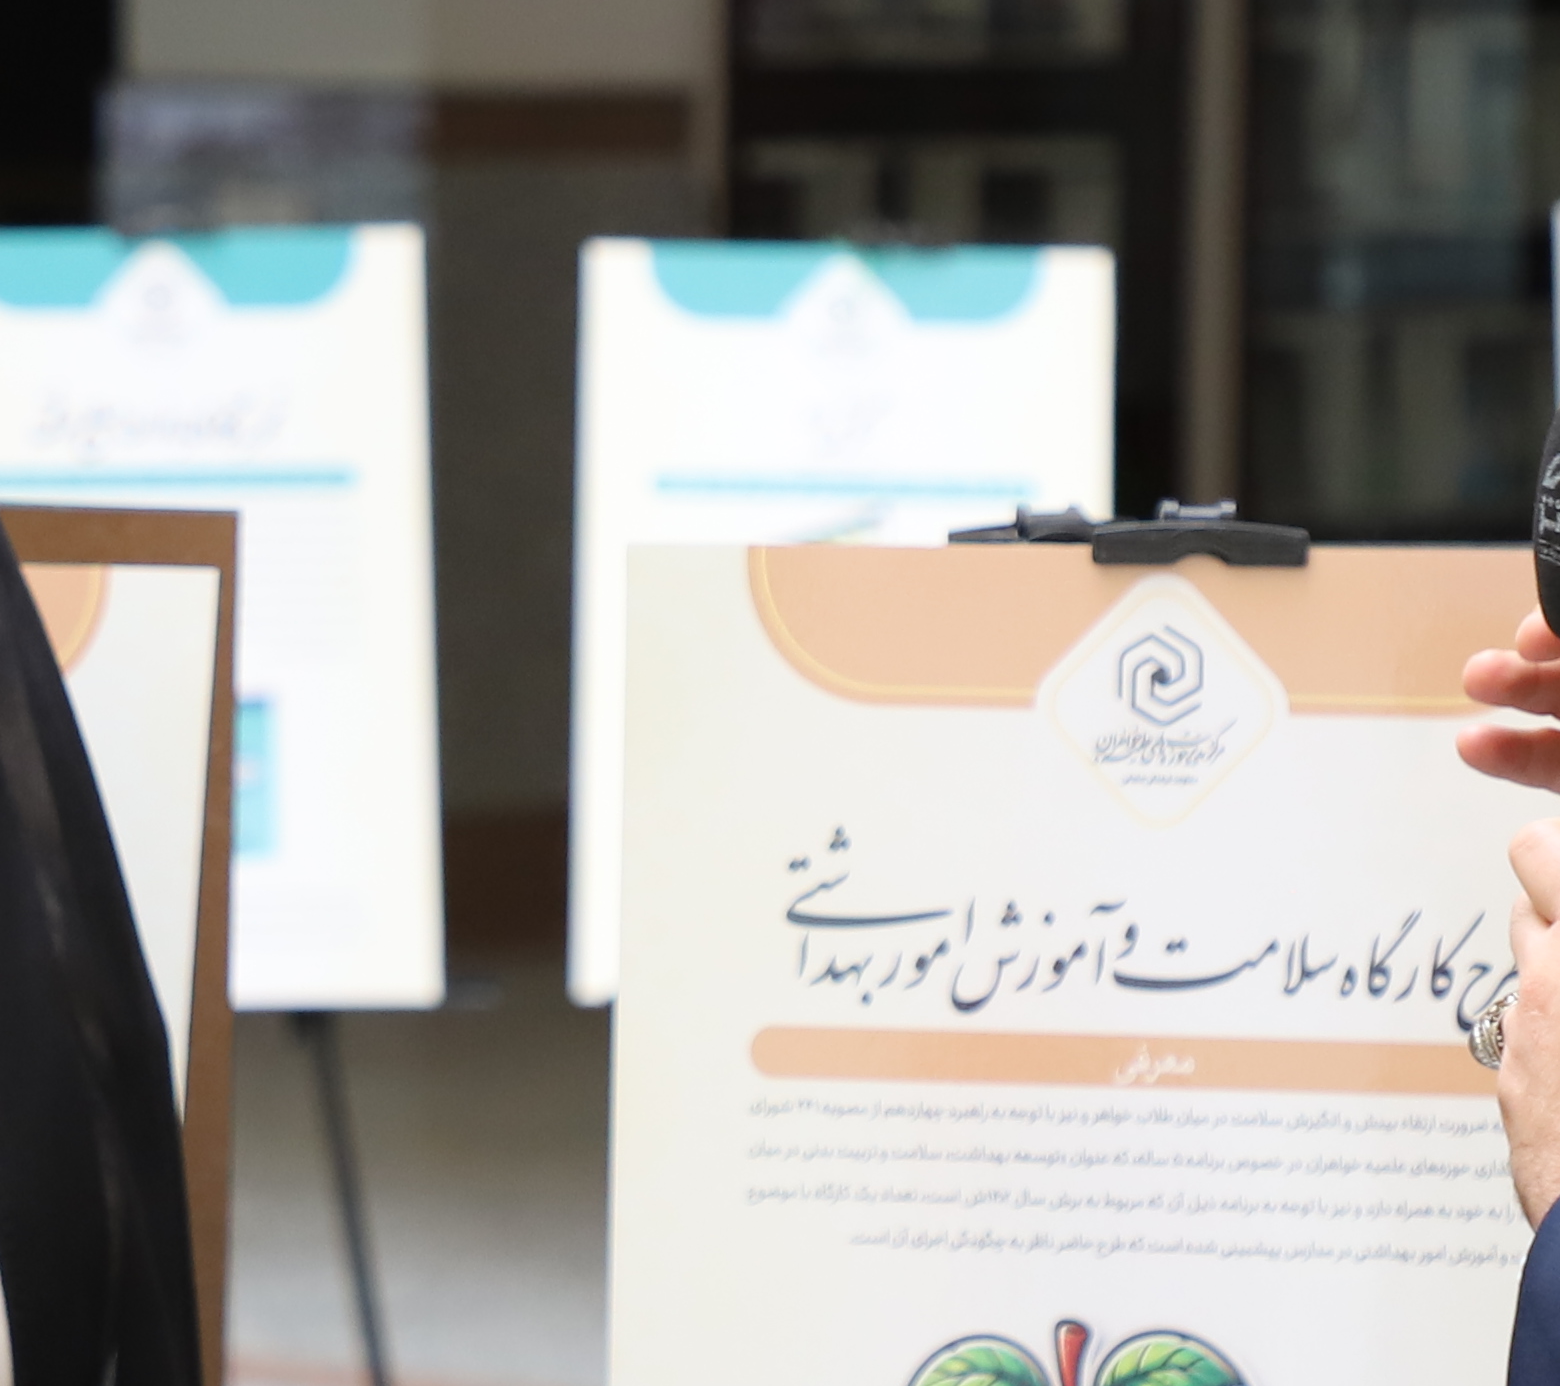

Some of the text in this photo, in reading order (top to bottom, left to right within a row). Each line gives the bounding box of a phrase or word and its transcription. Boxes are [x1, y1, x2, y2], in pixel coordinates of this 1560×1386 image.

[786, 824, 954, 1006] بهداشتی
[877, 895, 977, 991] امور
[951, 898, 1127, 1015] آموزش
[1113, 932, 1338, 994] سلامت
[1339, 908, 1486, 1002] کارگاه
